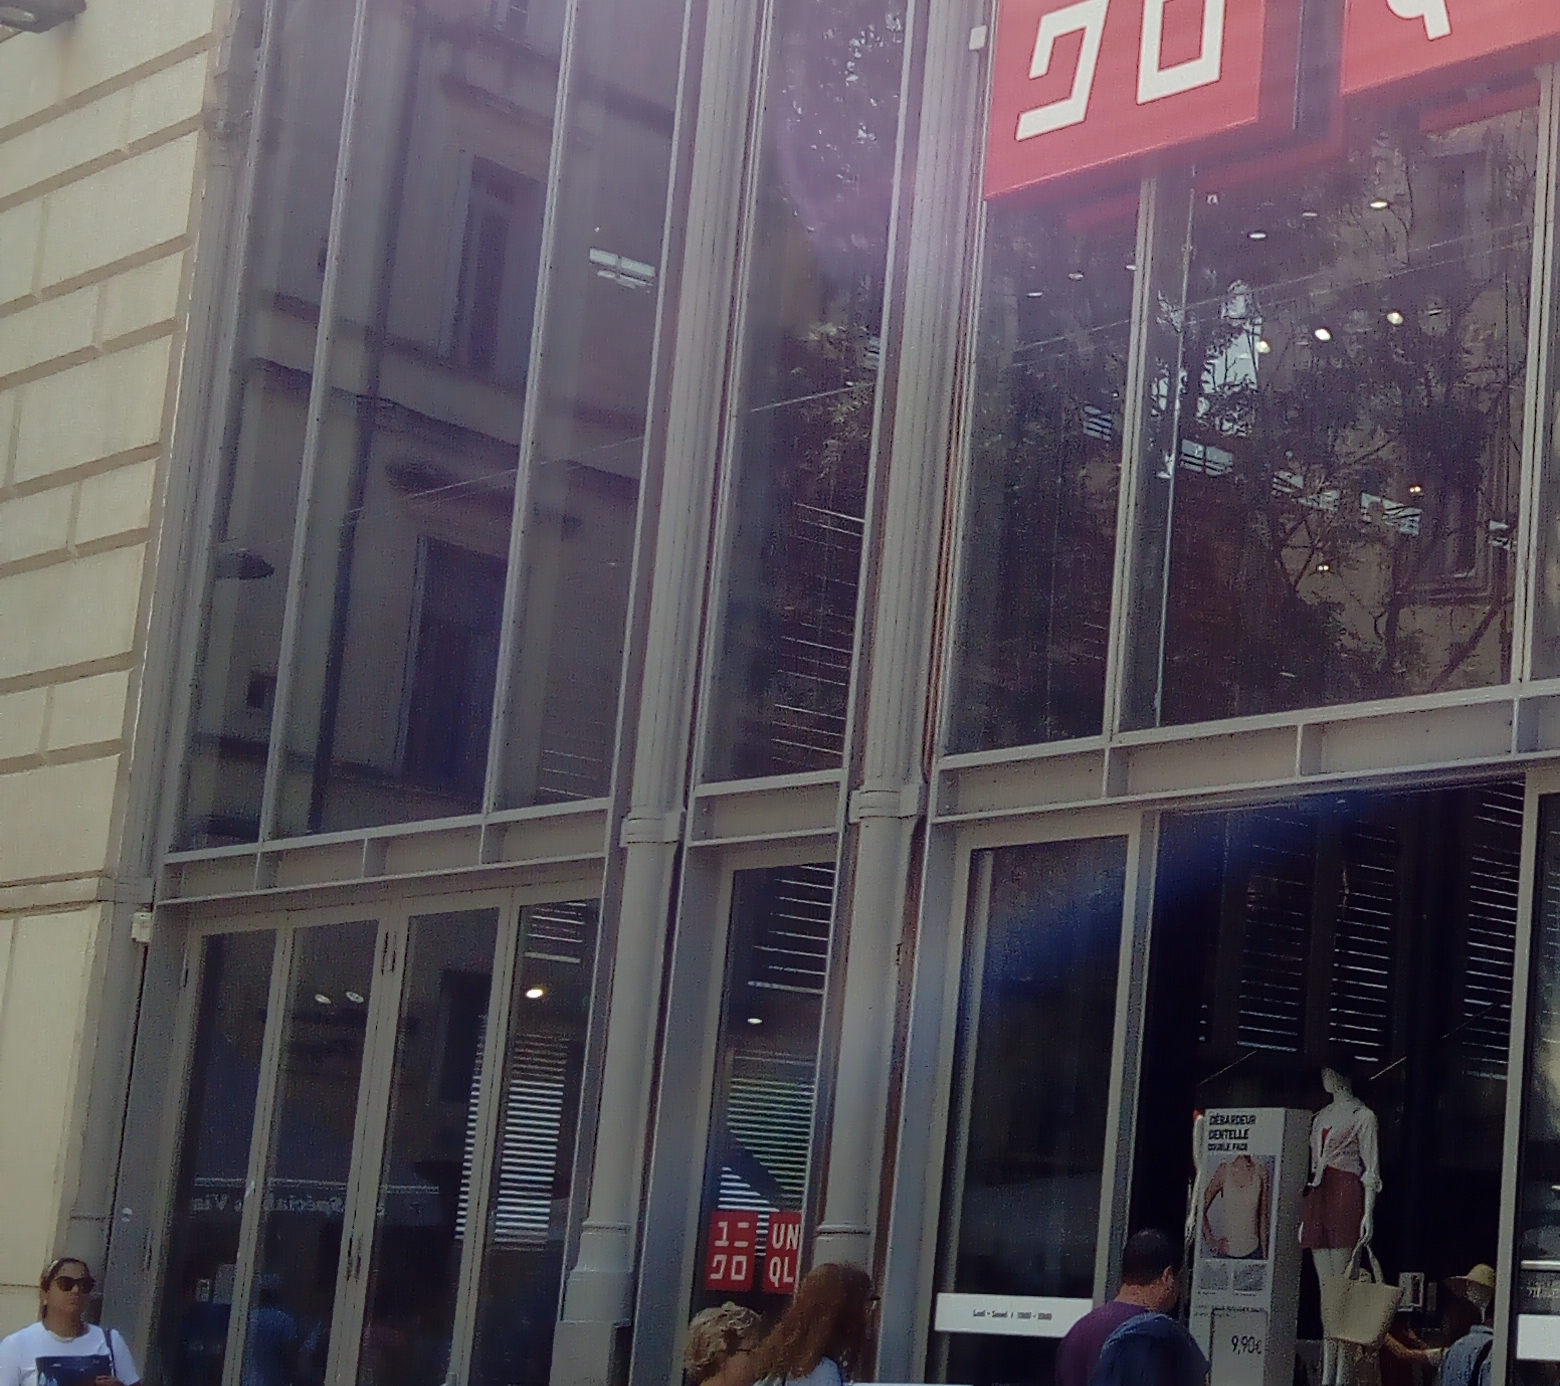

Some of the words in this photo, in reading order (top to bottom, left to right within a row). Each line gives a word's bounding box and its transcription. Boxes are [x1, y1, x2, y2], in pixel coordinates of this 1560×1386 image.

[714, 1221, 750, 1248] ユニ
[772, 1223, 800, 1250] UN
[709, 1254, 747, 1281] クロ
[769, 1256, 795, 1287] QL
